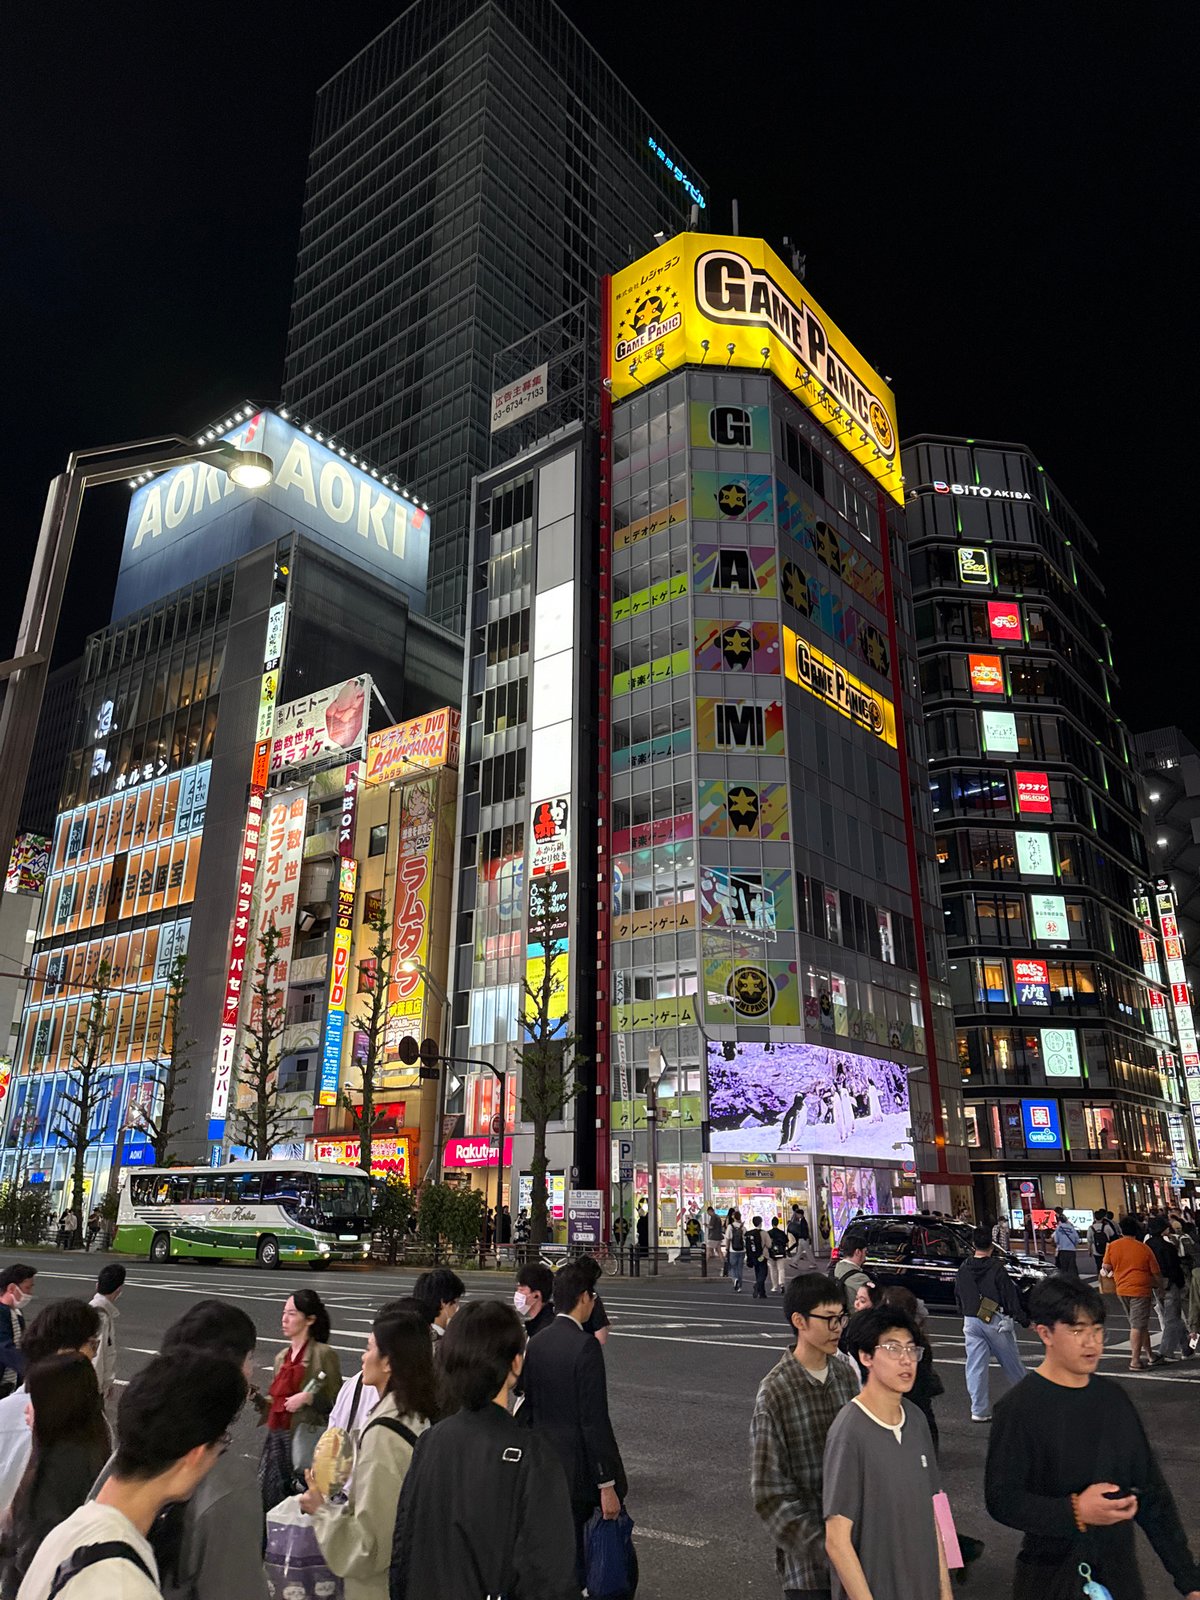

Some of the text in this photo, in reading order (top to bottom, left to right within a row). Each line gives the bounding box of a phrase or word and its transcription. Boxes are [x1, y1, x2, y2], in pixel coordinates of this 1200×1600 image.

[648, 137, 706, 209] 秋葉原ダイビル
[617, 317, 679, 360] GAME PANIC
[703, 257, 870, 425] GAME PANIC
[493, 386, 544, 421] 03-6734-7133
[496, 375, 542, 409] 広告主募集
[710, 405, 752, 448] G
[274, 437, 408, 560] AOKI
[993, 489, 1031, 500] AKIBA
[711, 547, 760, 593] A
[615, 584, 687, 620] アーケードゲーム
[266, 659, 278, 670] 8F
[799, 644, 869, 716] GAME PANIC
[286, 697, 329, 720] ハニトー
[297, 719, 304, 728] &
[425, 713, 445, 734] DVD
[274, 727, 326, 752] 曲数世界一
[271, 740, 324, 770] カラオケ
[115, 758, 168, 791] ホルモン
[188, 777, 207, 795] 24h
[1019, 783, 1047, 791] カラオケ
[186, 793, 205, 806] OEN
[193, 813, 206, 824] 4F
[533, 852, 567, 866] セセリ焼き
[234, 881, 254, 948] カラオケ
[394, 856, 429, 998] ラムタラ
[620, 914, 689, 937] クレーンゲーム
[225, 958, 244, 1010] パセラ
[330, 946, 348, 1004] DVD
[619, 1008, 692, 1028] クレーンゲーム
[214, 1034, 233, 1107] ダーツバー
[620, 1110, 694, 1127] クレーム
[129, 1149, 143, 1159] AOKI
[456, 1143, 500, 1159] Rakuten
[621, 1144, 631, 1159] P
